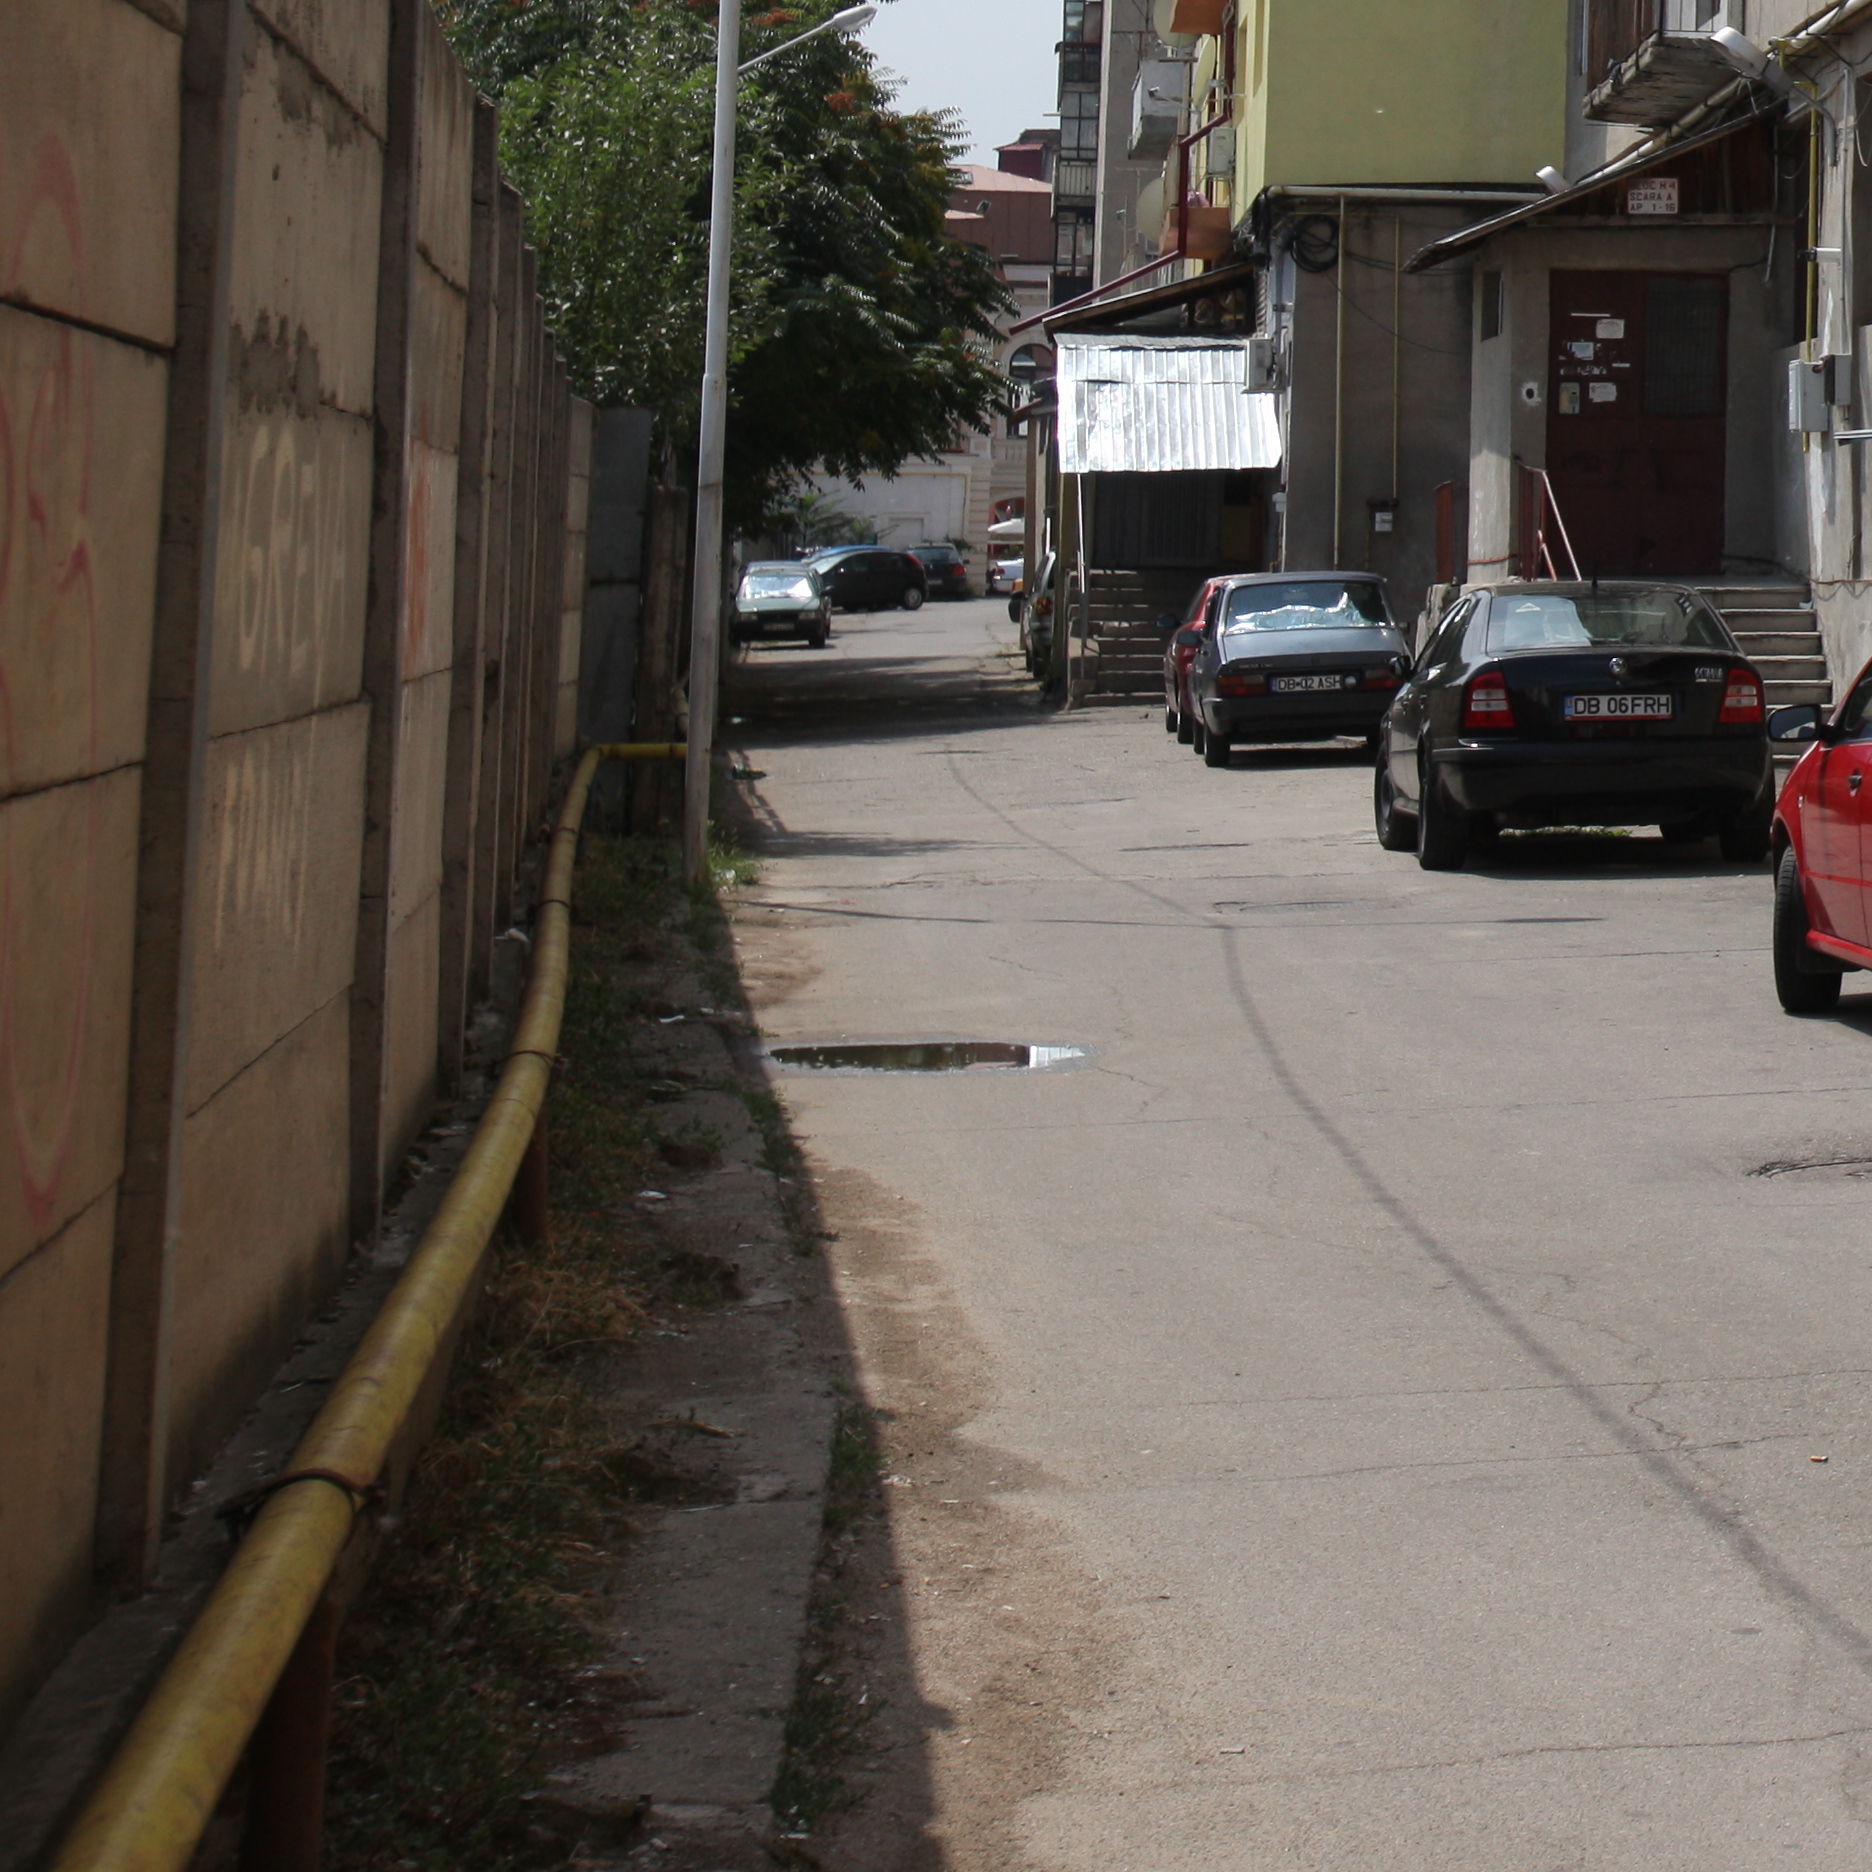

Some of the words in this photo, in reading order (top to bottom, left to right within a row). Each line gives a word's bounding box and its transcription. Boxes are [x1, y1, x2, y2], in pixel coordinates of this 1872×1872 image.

[1630, 192, 1662, 201] SCARA
[1666, 192, 1673, 201] A
[1630, 203, 1643, 211] AP
[1278, 678, 1296, 691] DB
[1317, 676, 1342, 689] ASH
[1574, 697, 1600, 715] DB
[1607, 696, 1670, 714] 06FRH
